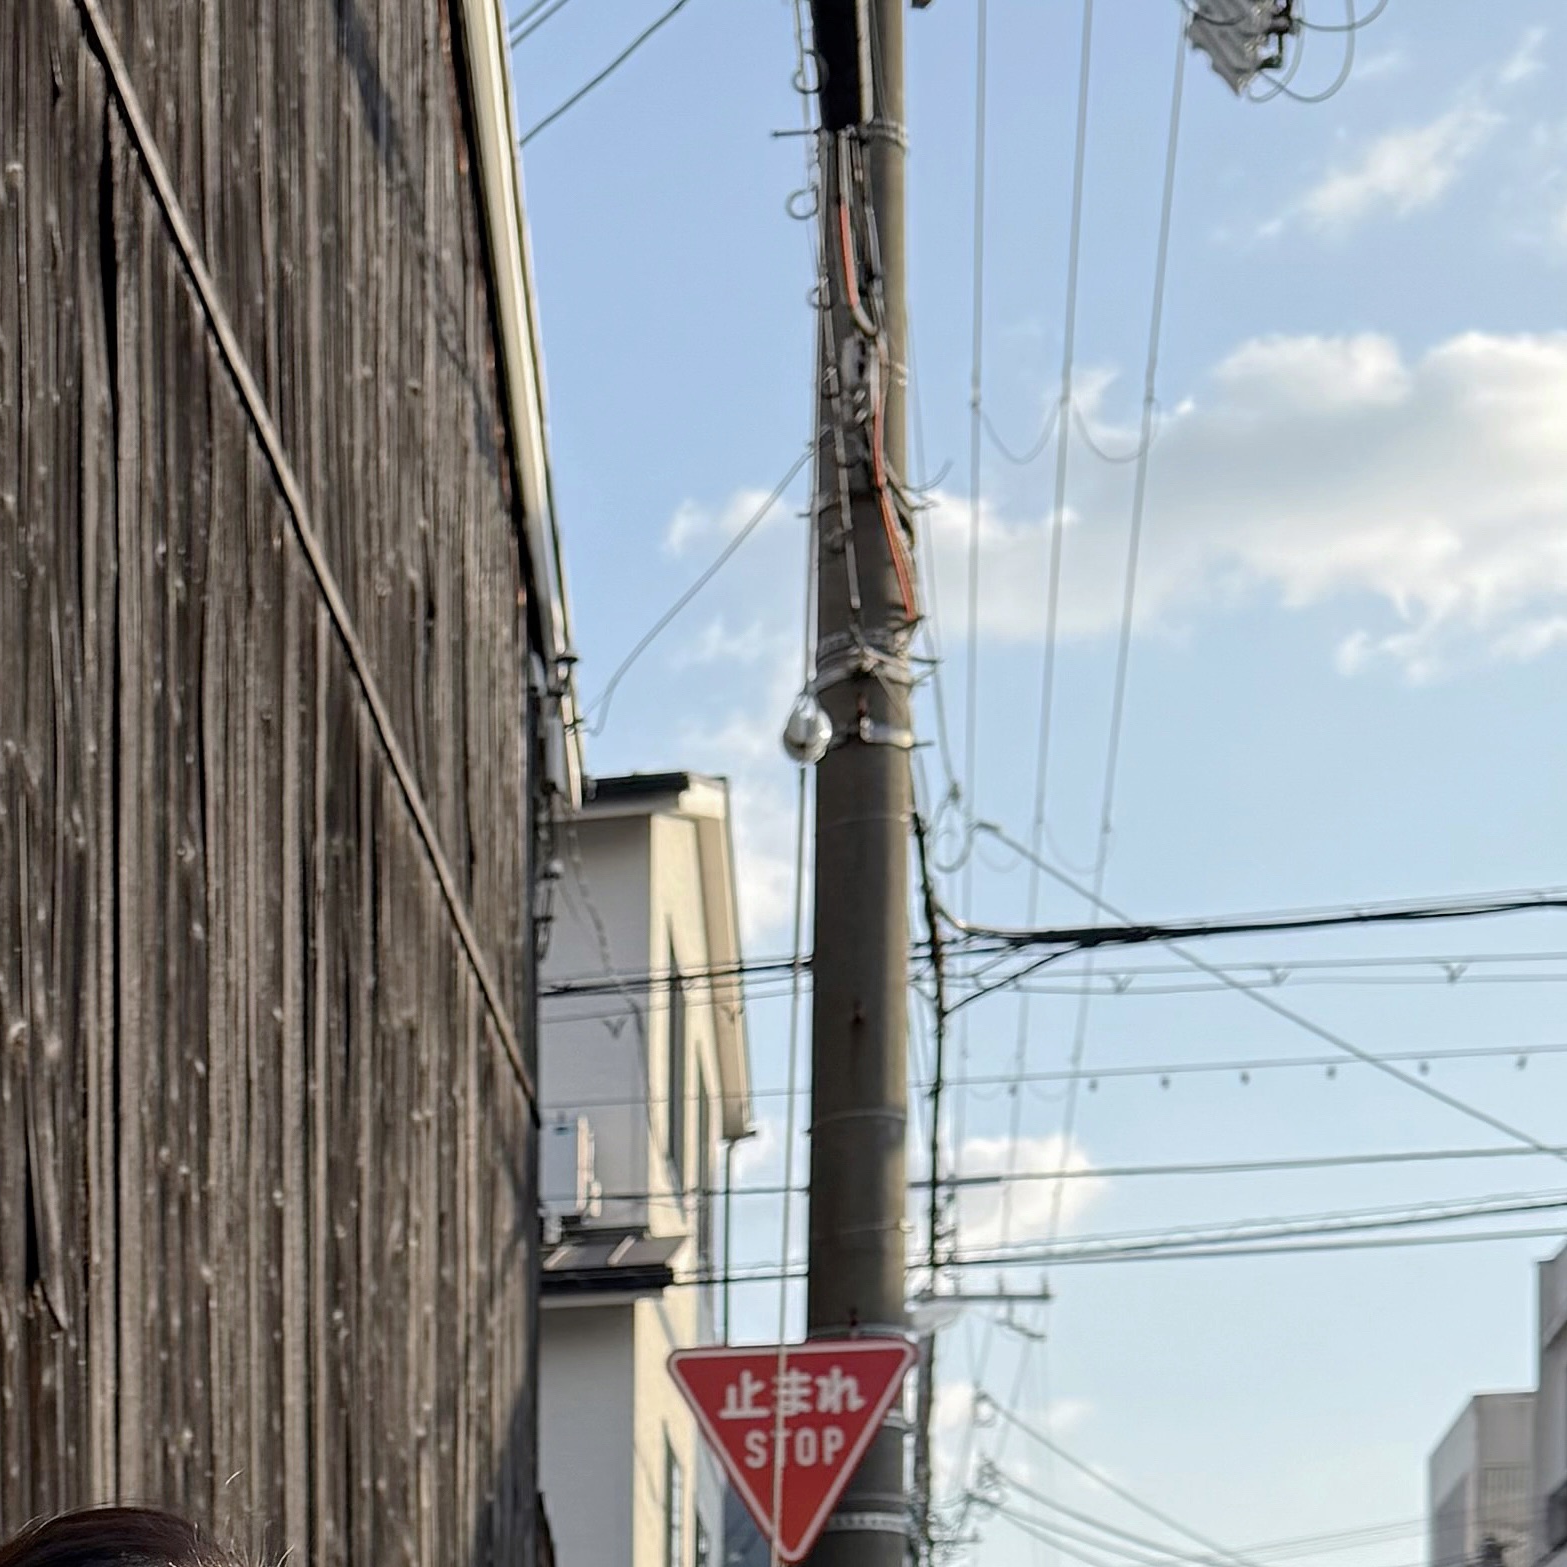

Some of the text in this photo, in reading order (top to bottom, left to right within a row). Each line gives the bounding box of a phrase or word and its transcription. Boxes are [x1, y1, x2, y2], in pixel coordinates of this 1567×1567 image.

[718, 1365, 867, 1420] 止まれ
[744, 1425, 845, 1469] STOP
